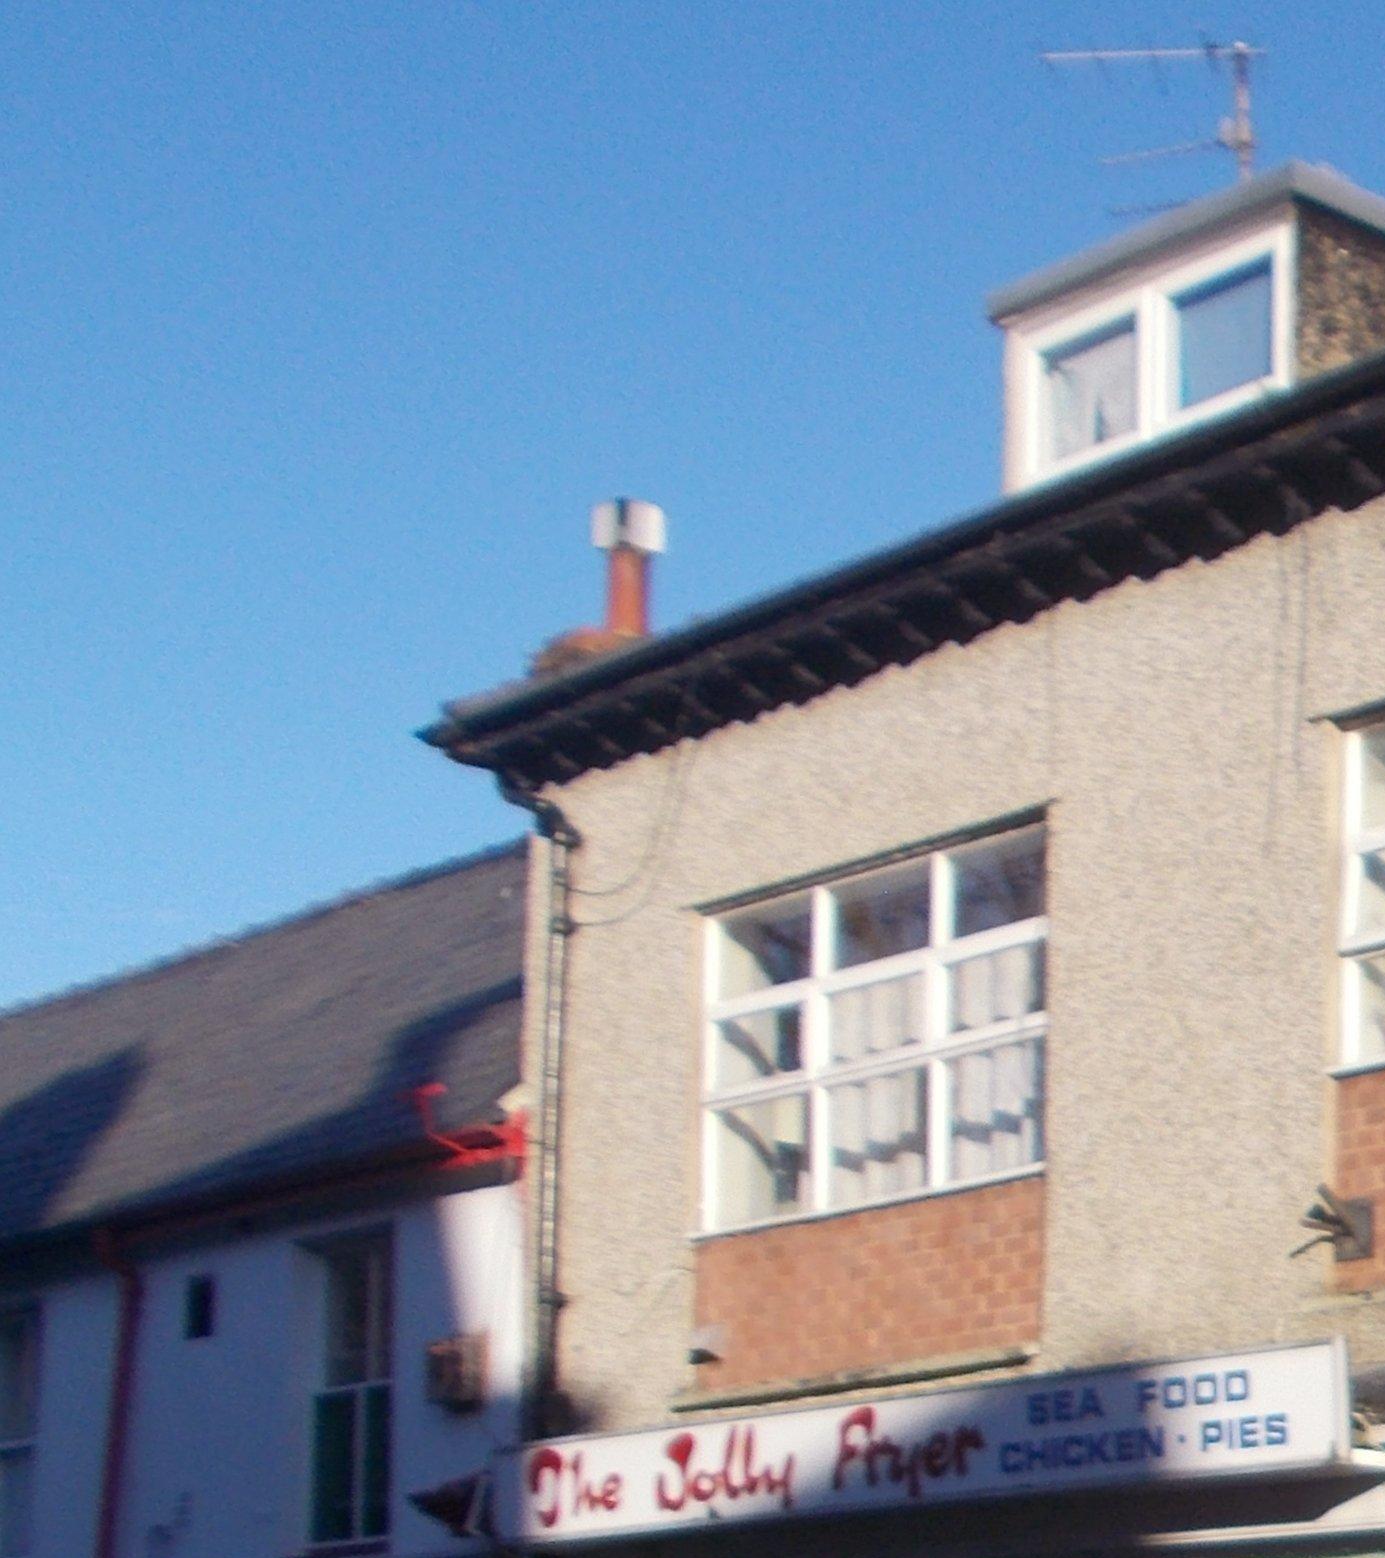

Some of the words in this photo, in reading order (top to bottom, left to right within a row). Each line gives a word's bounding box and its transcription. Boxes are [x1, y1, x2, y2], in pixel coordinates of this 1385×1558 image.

[1026, 1386, 1105, 1426] SEA
[1135, 1368, 1249, 1413] FOOD
[528, 1445, 624, 1528] The
[654, 1423, 796, 1512] Jolly
[832, 1404, 985, 1498] Fryer
[997, 1425, 1166, 1474] CHICKEN
[1201, 1411, 1291, 1452] PIES
